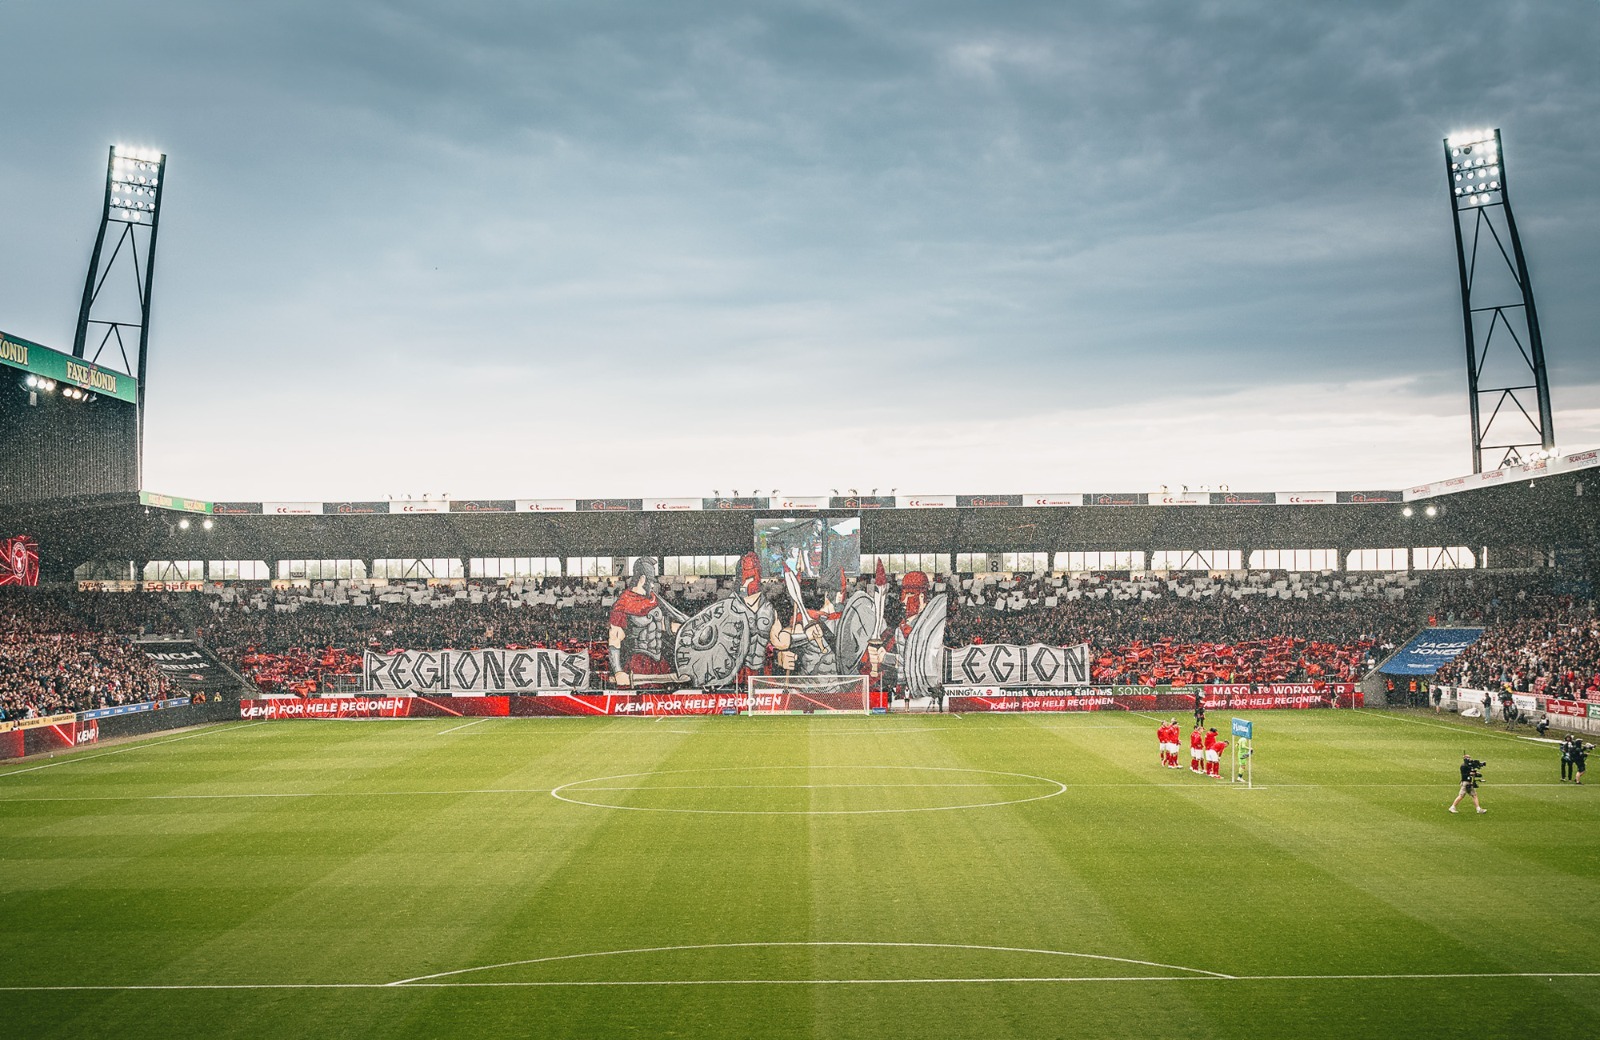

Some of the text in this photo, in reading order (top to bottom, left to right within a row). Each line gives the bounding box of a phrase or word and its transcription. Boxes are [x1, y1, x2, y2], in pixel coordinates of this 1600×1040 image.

[66, 361, 117, 393] FAXE KONDI
[991, 560, 999, 572] 8
[145, 651, 202, 660] MCH
[365, 651, 587, 691] REGIONENS
[942, 645, 1086, 684] LEGION
[240, 700, 403, 717] KÆMP FOR HELE REGIONEN
[614, 696, 781, 712] KÆMP FOR HELE REGIONEN
[1042, 699, 1066, 707] HELE
[1067, 697, 1114, 706] REGIONEN
[1229, 698, 1248, 707] FOR
[1249, 697, 1273, 706] HELE
[1274, 695, 1321, 705] REGIONEN
